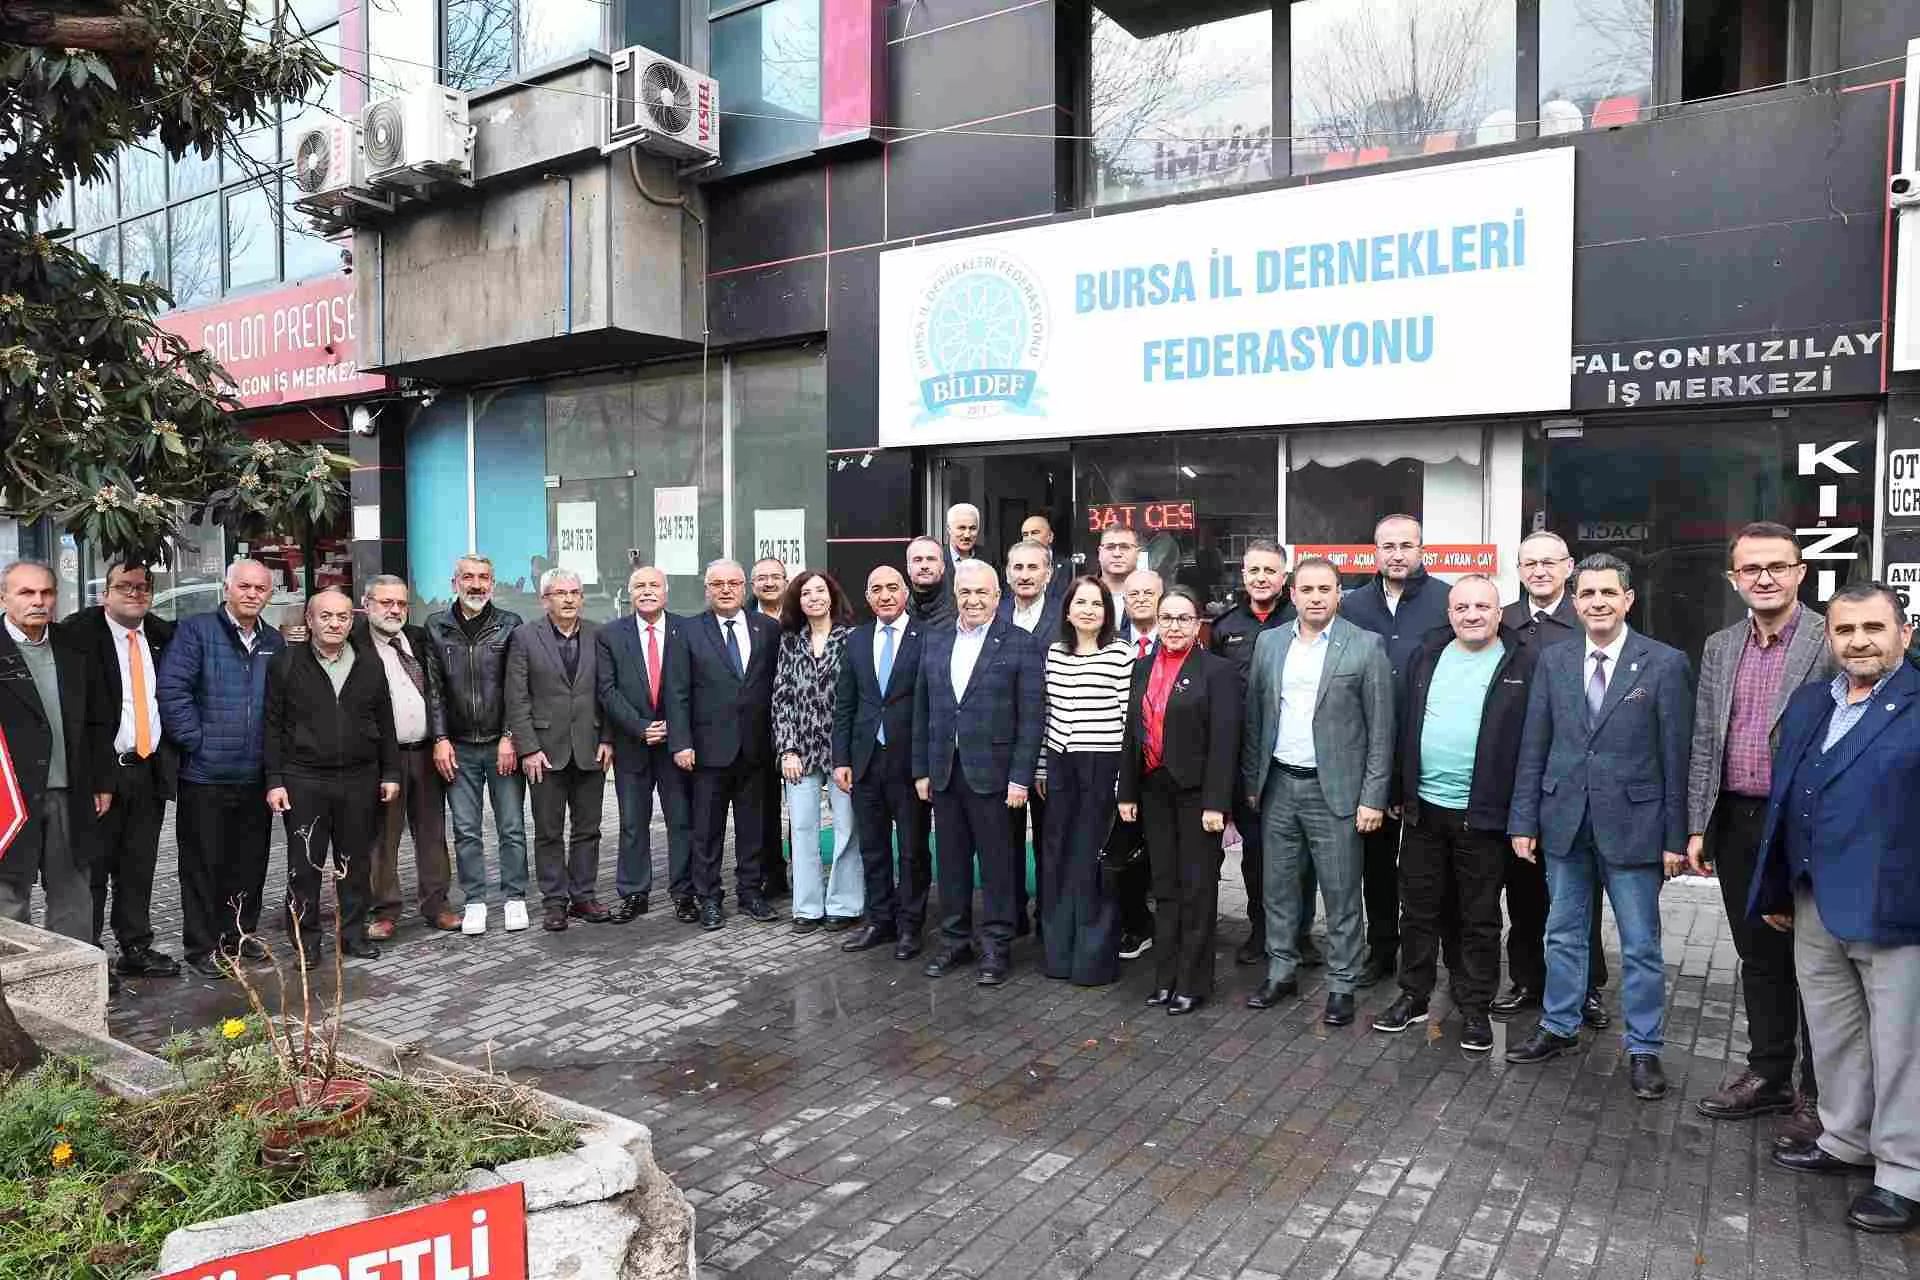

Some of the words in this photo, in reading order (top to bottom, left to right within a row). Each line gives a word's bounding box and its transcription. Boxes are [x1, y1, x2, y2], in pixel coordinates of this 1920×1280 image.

[698, 81, 711, 143] VESTEL
[1075, 261, 1196, 314] BURSA
[1209, 247, 1242, 300] İL
[1255, 207, 1527, 295] DERNEKLERİ
[1142, 315, 1435, 383] FEDERASYONU
[292, 361, 362, 390] MERKEZ
[931, 374, 1025, 403] BİLDEF
[1608, 379, 1641, 407] İŞ
[1655, 365, 1832, 401] MERKEZİ
[1445, 552, 1472, 568] AYRAN
